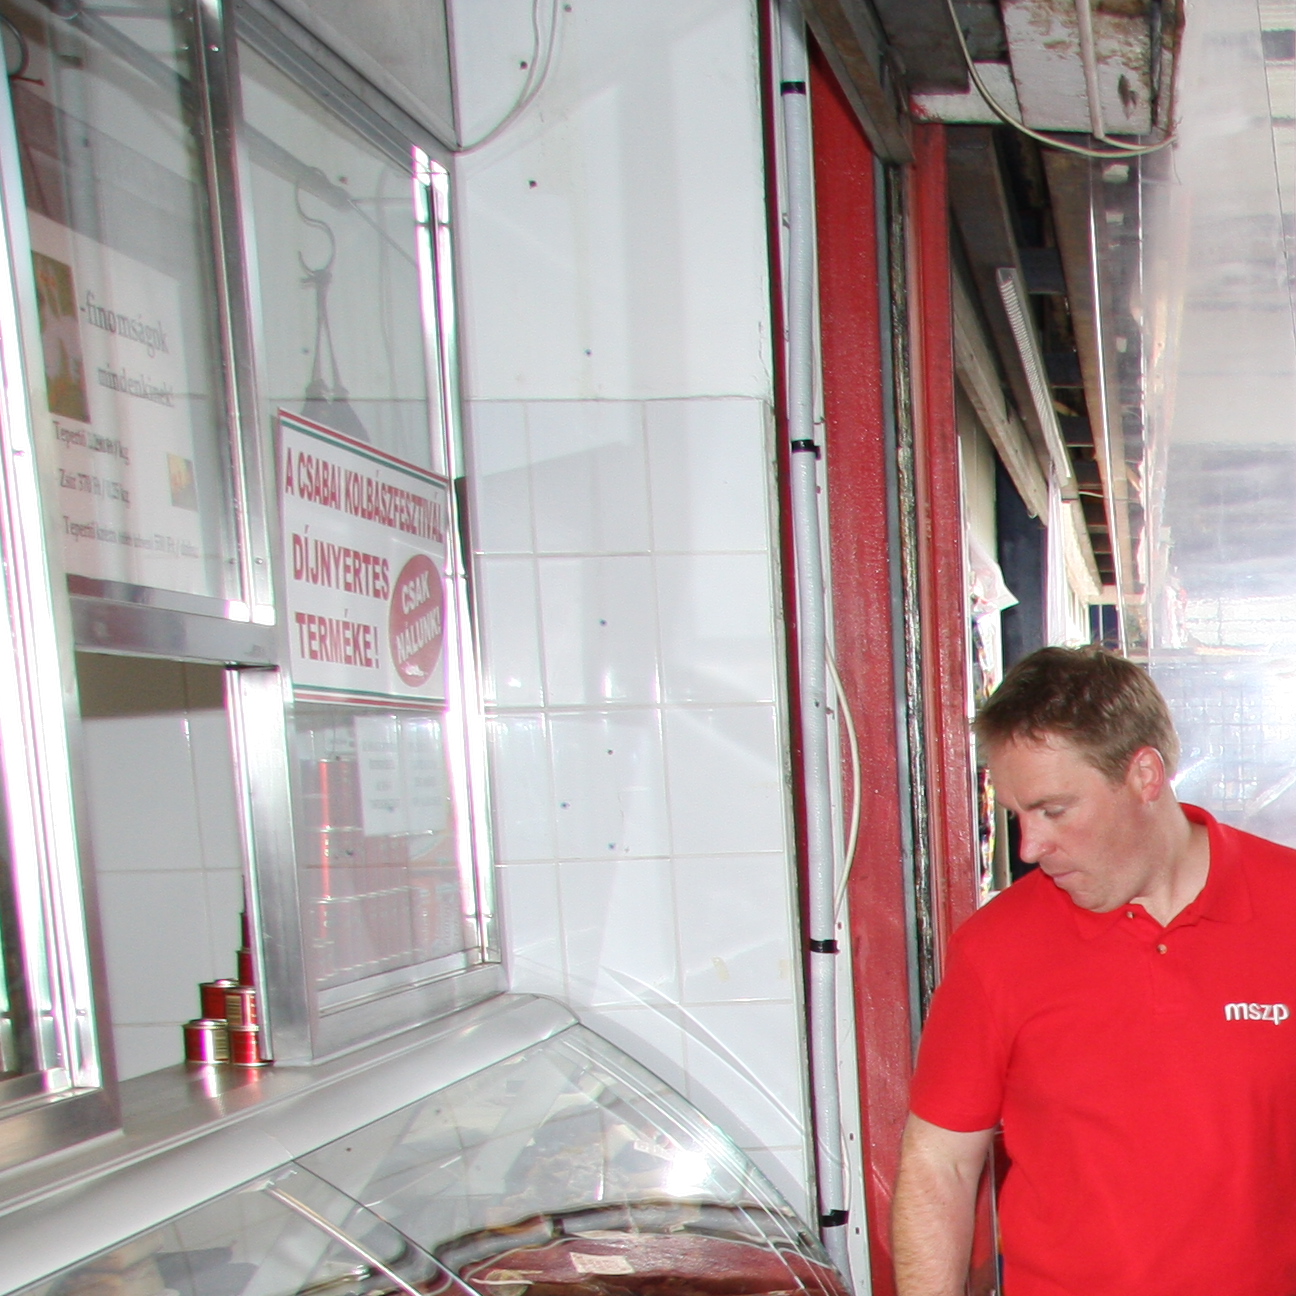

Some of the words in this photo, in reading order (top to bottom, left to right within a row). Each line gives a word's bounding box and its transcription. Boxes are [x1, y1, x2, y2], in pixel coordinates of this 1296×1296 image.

[285, 446, 294, 496] A
[298, 451, 342, 512] CSABAI
[344, 468, 443, 544] KOLBÁSZFESZTIVÁL
[292, 524, 390, 601] DÍJNYERTES
[402, 570, 431, 616] CSAK
[294, 607, 380, 669] TERMÉKE!
[395, 605, 442, 664] NÁLUNK!
[1224, 1003, 1291, 1025] mszp
